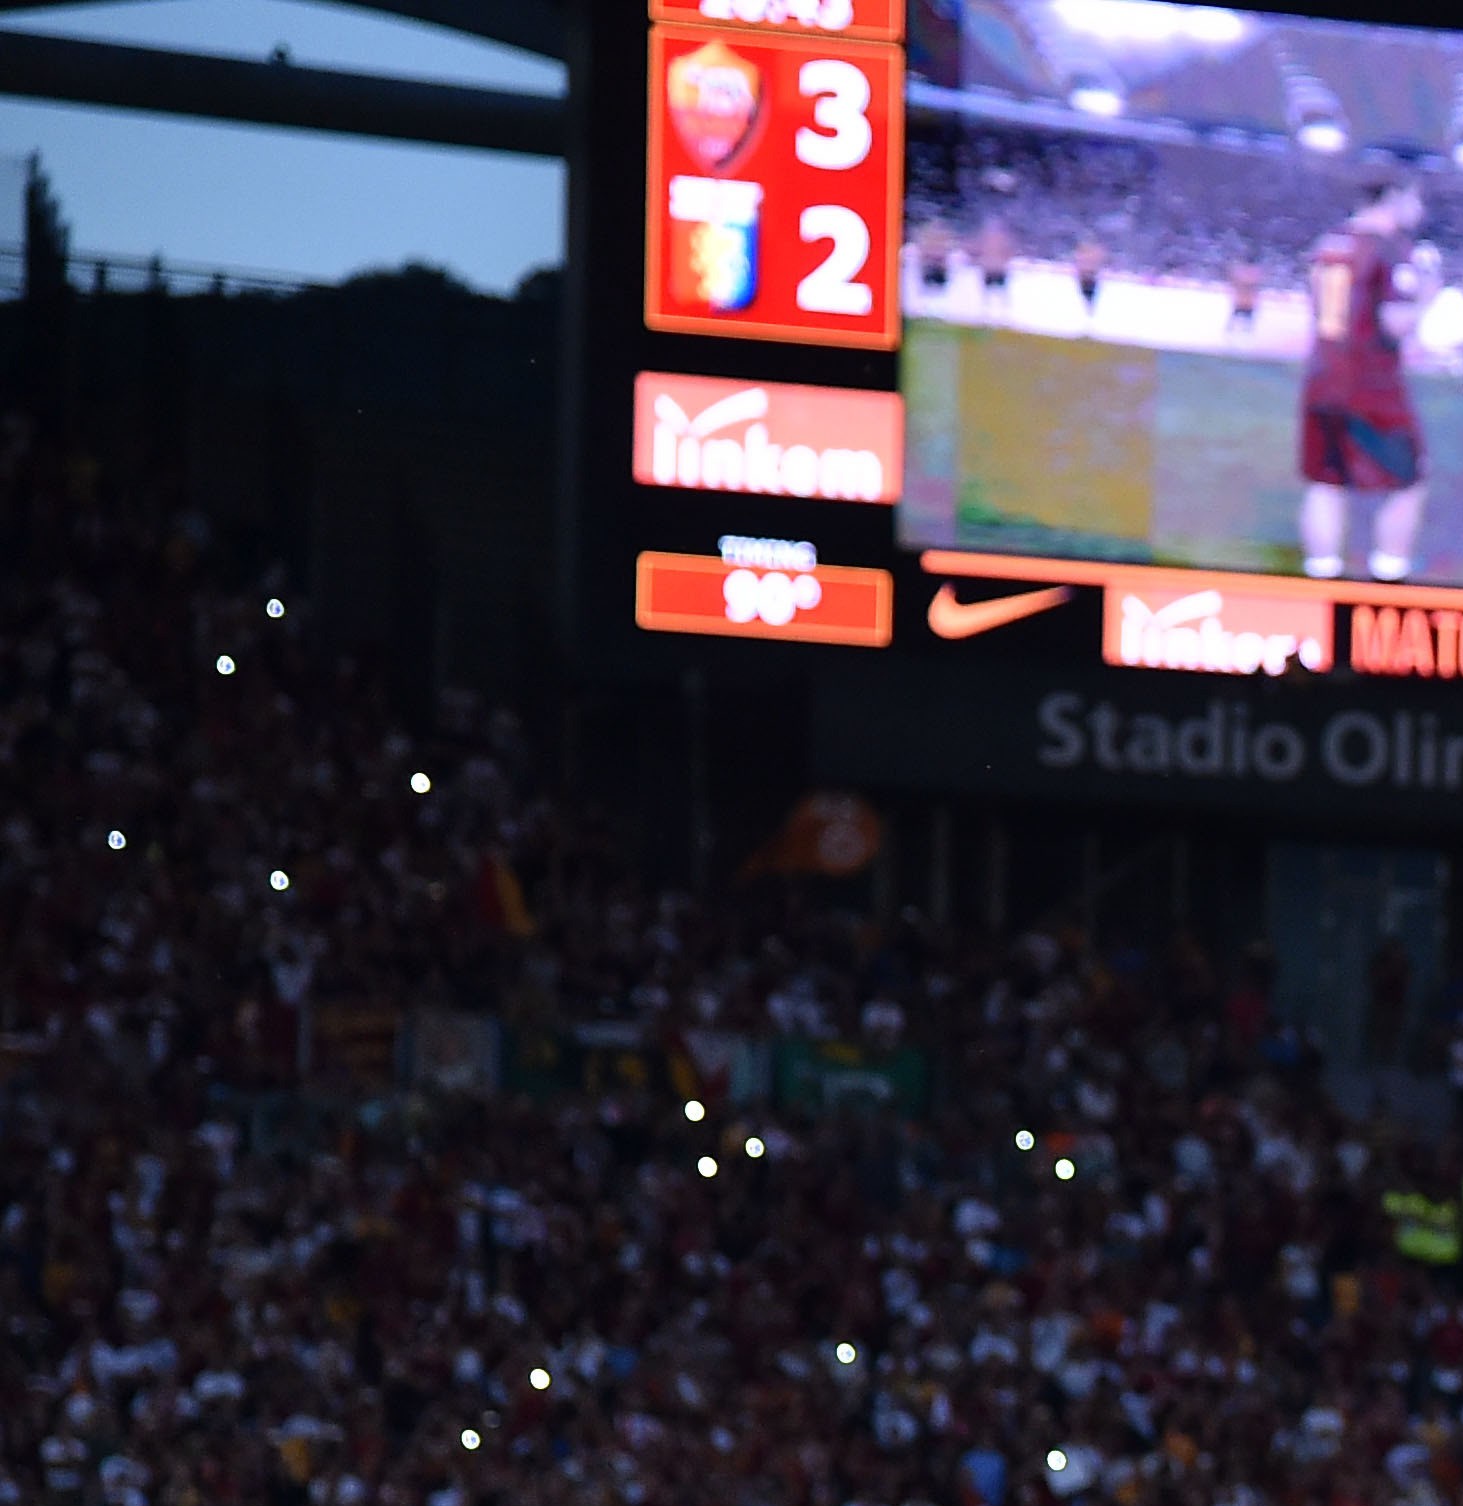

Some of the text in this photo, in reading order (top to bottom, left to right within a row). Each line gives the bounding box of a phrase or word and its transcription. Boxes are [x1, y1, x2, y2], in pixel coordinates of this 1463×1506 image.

[795, 59, 873, 171] 3
[796, 204, 873, 315] 2
[1037, 692, 1303, 781] Stadio
